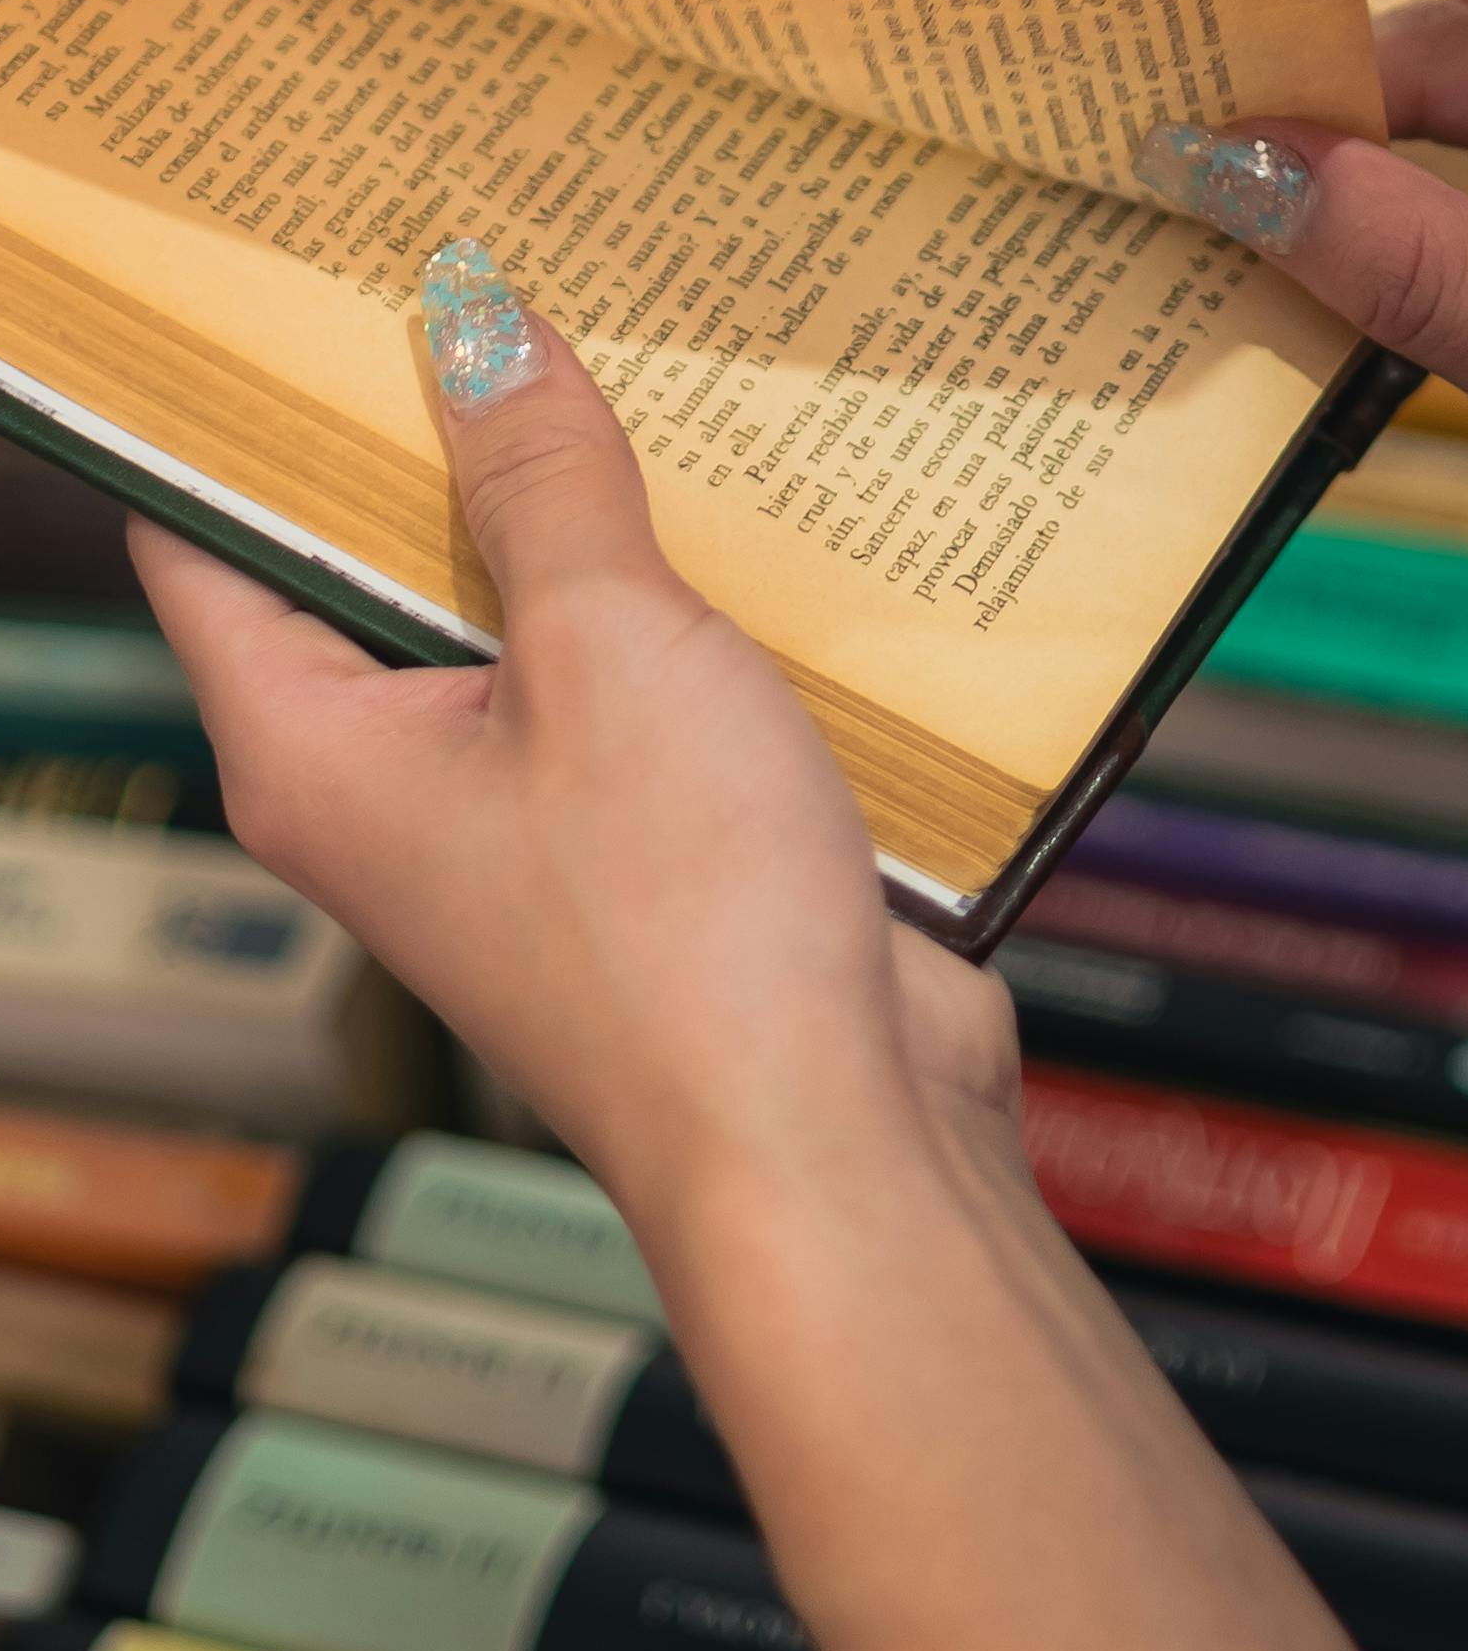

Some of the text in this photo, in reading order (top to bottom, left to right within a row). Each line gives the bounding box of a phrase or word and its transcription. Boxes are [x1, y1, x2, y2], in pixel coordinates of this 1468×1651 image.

[43, 99, 70, 122] su
[119, 127, 172, 168] baba
[185, 166, 220, 201] que
[218, 139, 241, 163] el
[232, 150, 318, 232] llero más
[288, 236, 326, 264] las
[388, 120, 424, 153] del
[270, 194, 325, 253] gentil;
[317, 196, 406, 280] le exigían
[356, 160, 475, 297] que Bellome le
[380, 204, 482, 313] ñía su
[500, 237, 533, 274] que
[610, 274, 633, 296] y
[626, 219, 671, 272] suave
[670, 192, 696, 216] en
[676, 276, 711, 312] aún
[740, 214, 759, 229] a
[848, 224, 873, 247] su
[514, 279, 542, 302] de
[537, 219, 633, 327] y fino, sus
[609, 233, 694, 344] sentimiento?
[764, 282, 827, 345] belleza
[646, 294, 736, 402] a su cuarto
[738, 376, 756, 392] o
[743, 400, 820, 484] Parecería
[817, 306, 897, 392] imposible,
[745, 352, 777, 372] la
[756, 472, 808, 519] biera
[806, 390, 868, 465] recibido
[858, 363, 890, 384] la
[885, 316, 925, 354] vida
[936, 251, 972, 279] las
[646, 433, 673, 458] su
[676, 449, 702, 473] su
[697, 398, 741, 444] alma
[706, 423, 763, 488] en ella.
[796, 324, 956, 534] cruel y de un carácter
[824, 355, 976, 552] aún, tras unos rasgos
[849, 312, 1048, 566] Sancerre escondía un alma
[884, 339, 1067, 582] capaz, en una palabra, de
[912, 387, 1075, 603] provocar esas pasiones.
[951, 348, 1144, 595] Demasiado célebre era en
[973, 519, 1059, 631] relajamiento
[1054, 483, 1085, 510] de
[1084, 443, 1114, 477] sus
[1114, 339, 1189, 435] costumbres
